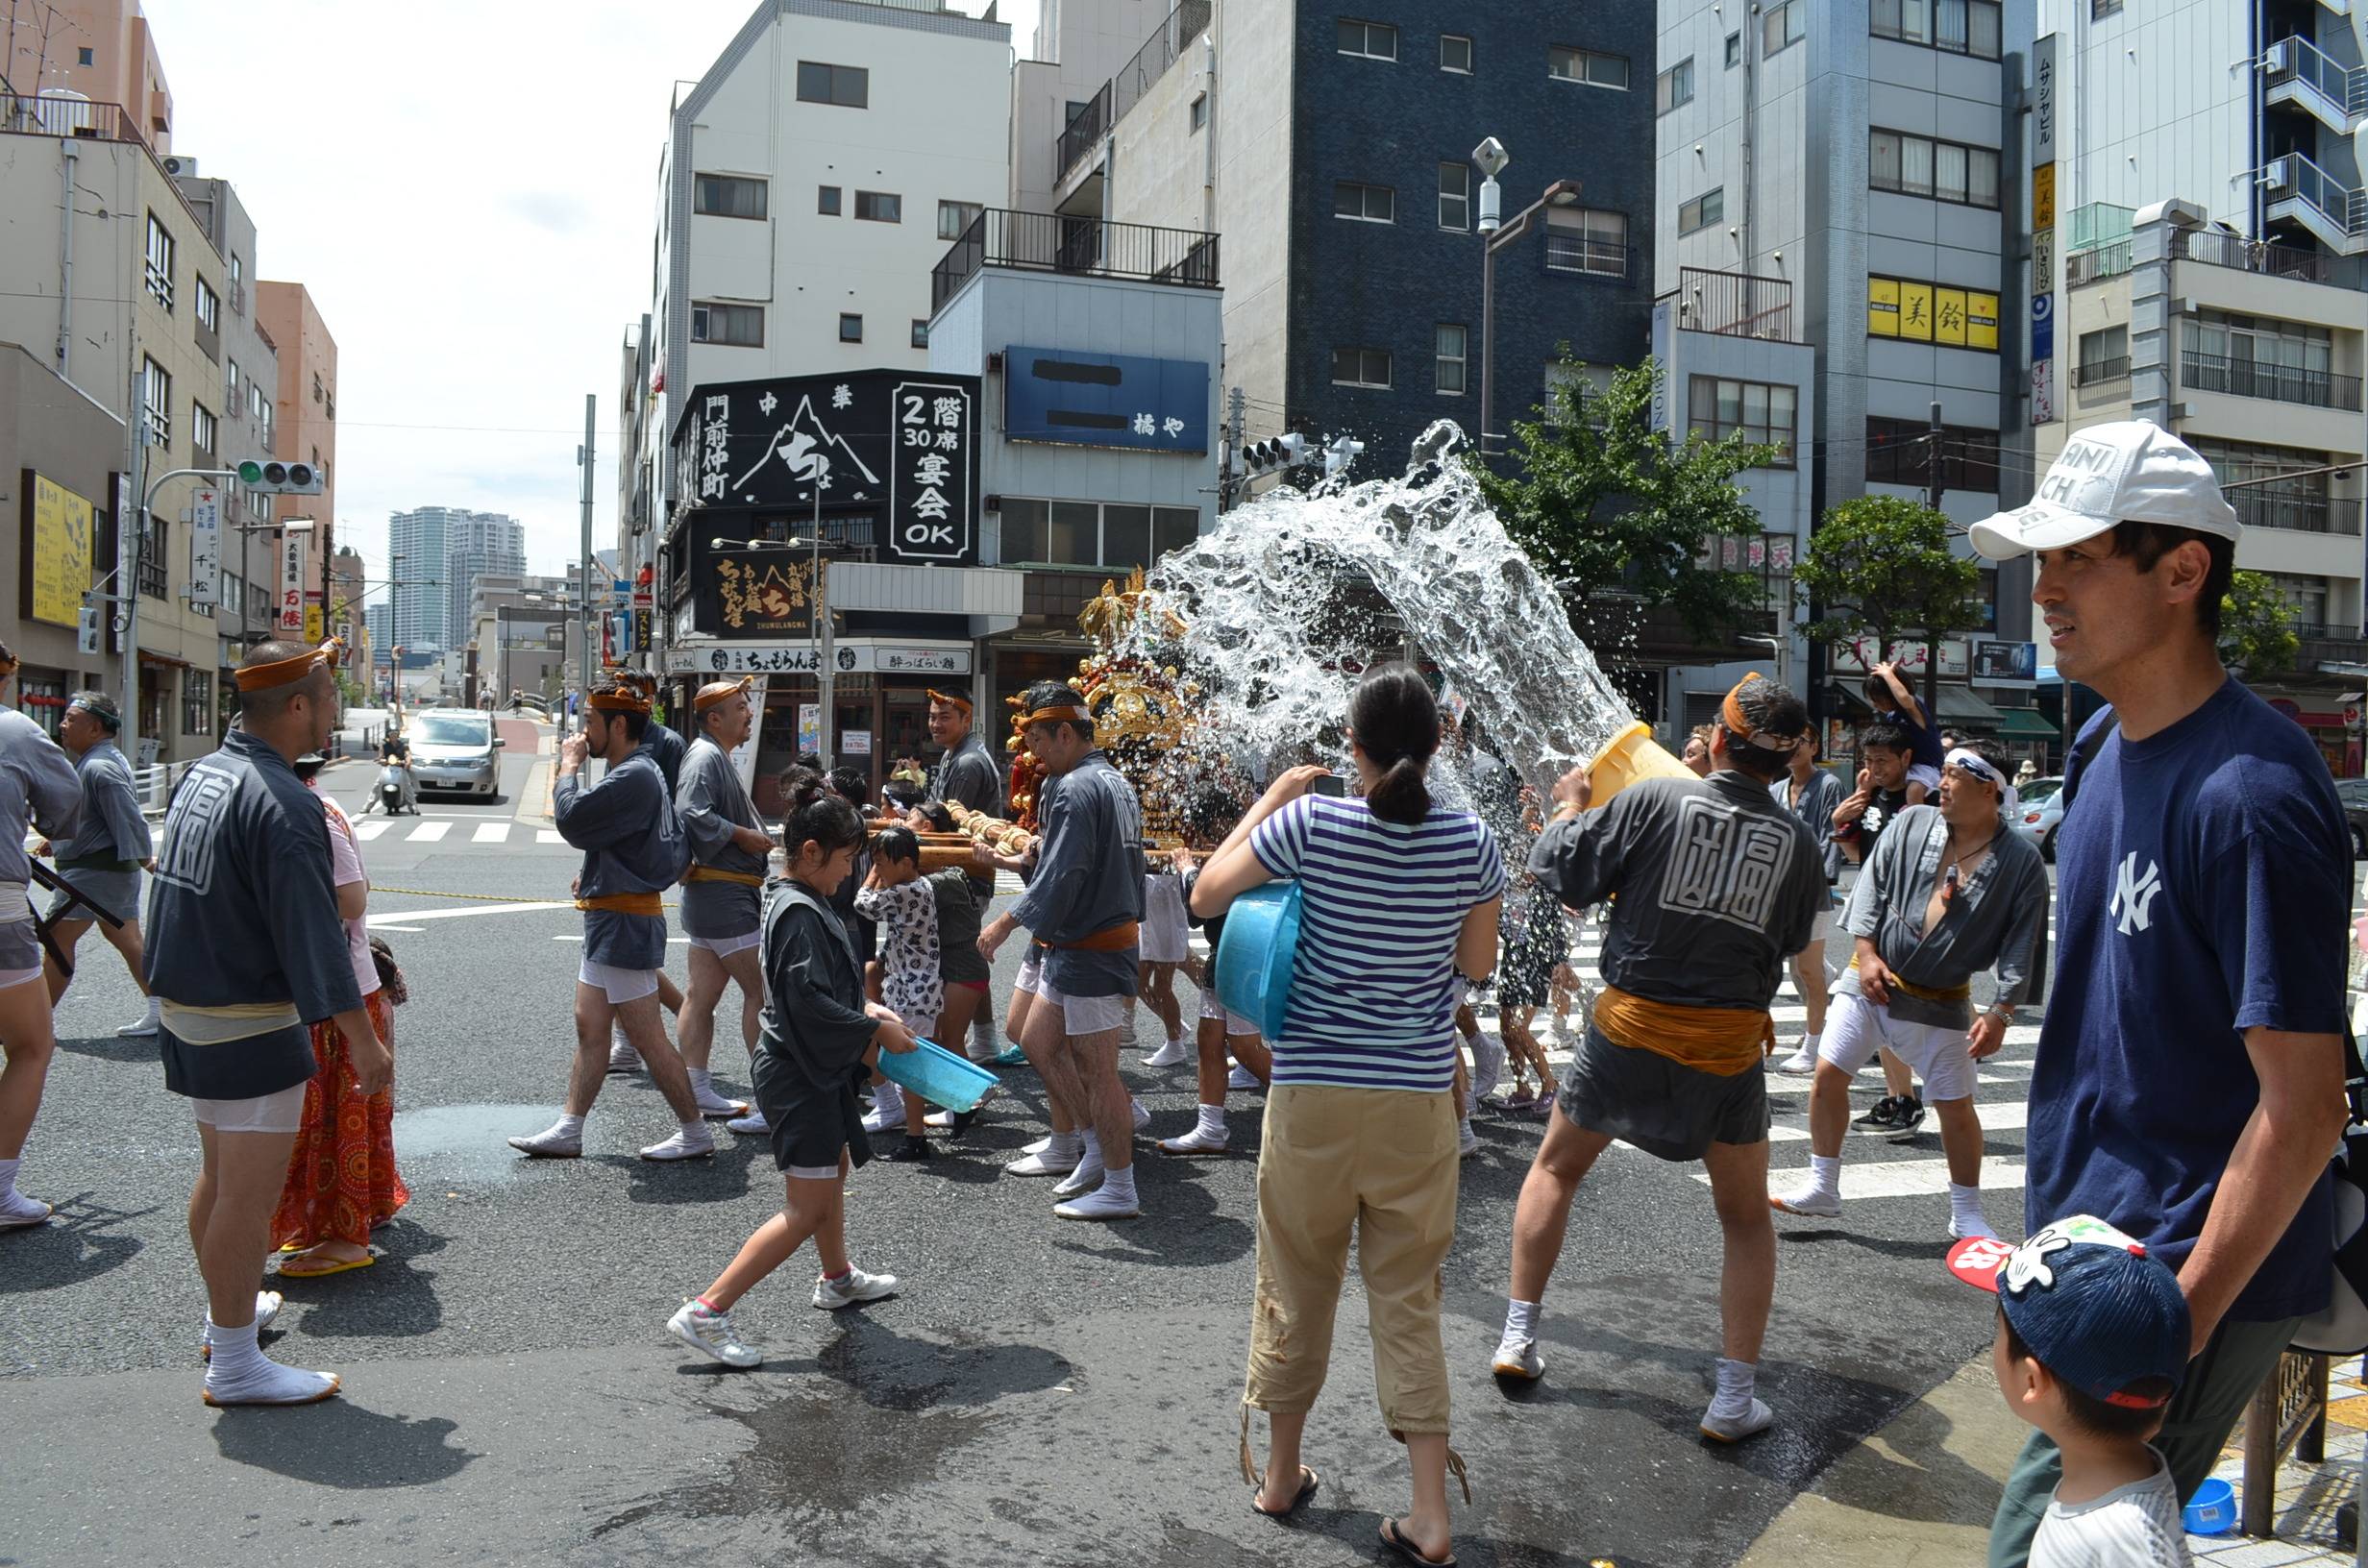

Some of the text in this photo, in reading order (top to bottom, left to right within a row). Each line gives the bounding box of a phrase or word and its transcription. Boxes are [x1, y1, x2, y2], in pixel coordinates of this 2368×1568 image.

[2038, 58, 2052, 146] ムサシヤビル
[701, 394, 730, 500] 門前仲町
[912, 453, 951, 520] 宴会
[904, 524, 954, 545] OK
[194, 554, 209, 593] 千松
